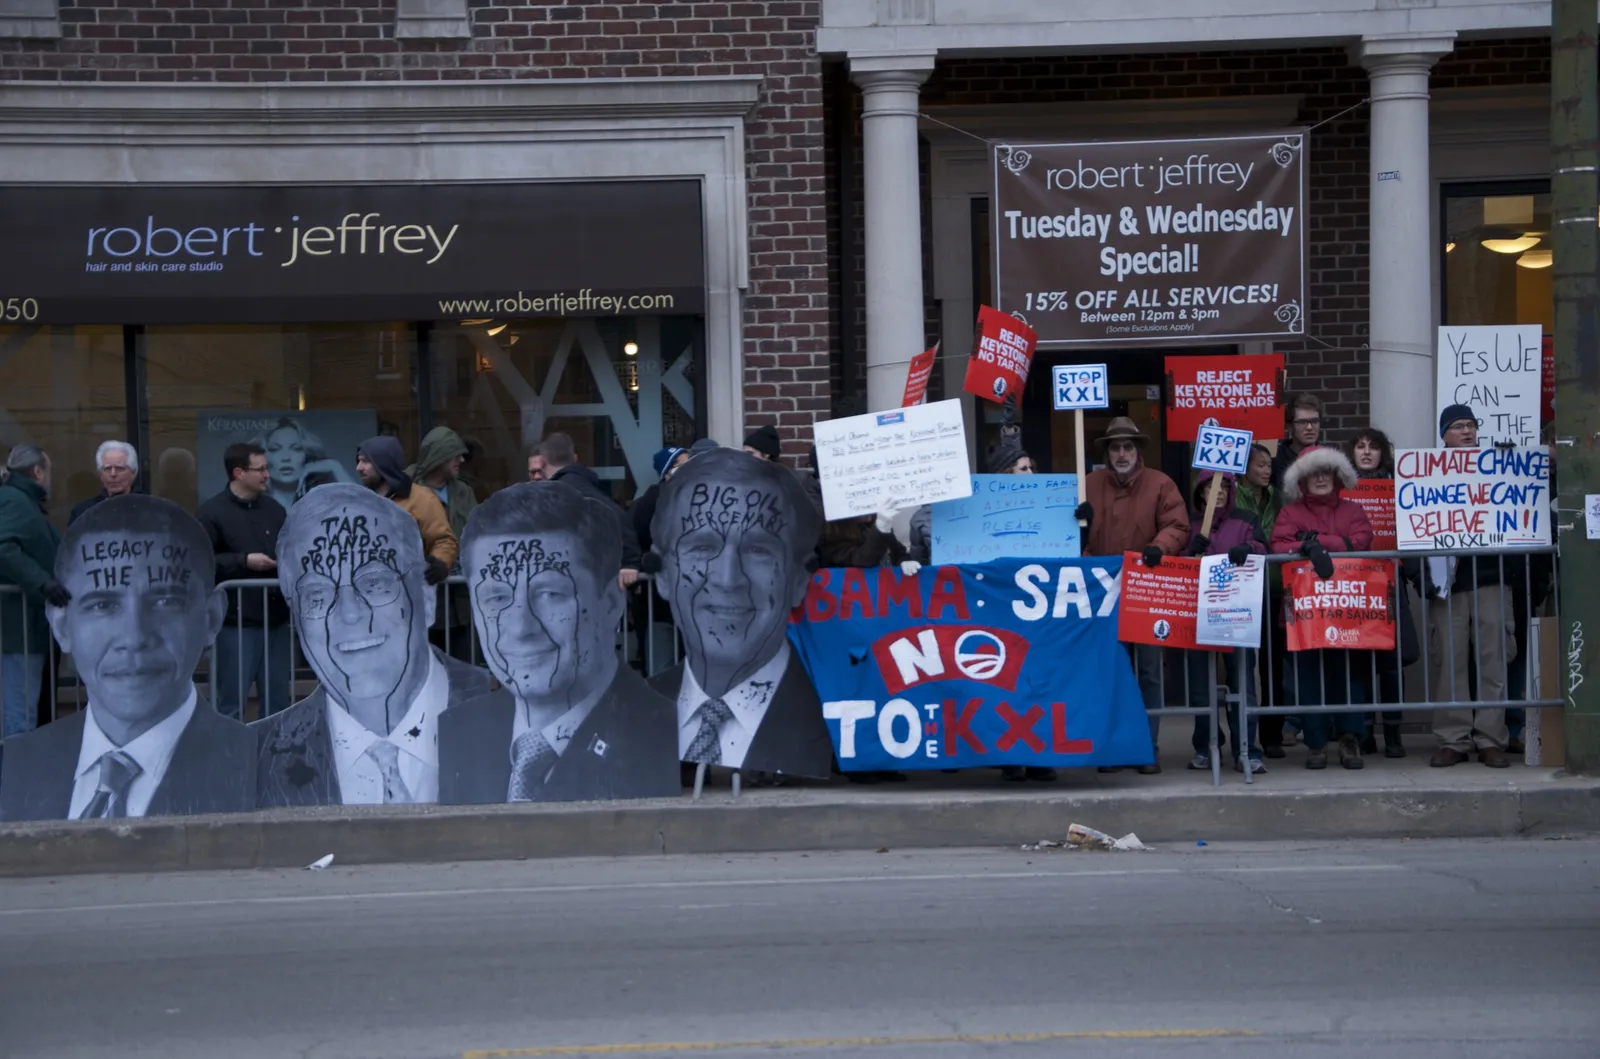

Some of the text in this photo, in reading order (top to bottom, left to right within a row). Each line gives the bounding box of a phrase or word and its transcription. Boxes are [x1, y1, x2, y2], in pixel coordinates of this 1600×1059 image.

[1004, 201, 1294, 243] Tuesday & Wednesday
[86, 261, 223, 272] hair and skin care studio
[1100, 243, 1199, 281] Special!
[438, 288, 674, 316] www.robertjeffrey.com
[1024, 284, 1279, 311] 15% OFF ALL SERVICES!
[0, 297, 39, 320] 50
[1081, 307, 1220, 323] Between 12pm & 3pm
[1106, 323, 1194, 334] (Some Exclusions Apply)
[999, 328, 1029, 353] REJECT
[978, 349, 995, 363] NO
[997, 355, 1015, 371] TAR
[1447, 333, 1489, 377] YES
[1495, 332, 1538, 373] WE
[1058, 370, 1101, 385] STOP
[1197, 370, 1252, 383] REJECT
[1059, 387, 1103, 403] KXL
[1175, 383, 1275, 398] KEYSTONE XL
[1176, 396, 1275, 408] NO TAR SANDS
[1490, 413, 1532, 436] THE
[1202, 432, 1246, 448] STOP
[1199, 447, 1243, 467] KXL
[1397, 449, 1481, 479] CLIMATE
[1046, 480, 1077, 489] FAMIL
[691, 483, 782, 516] BIG OIL
[1399, 480, 1545, 510] CHANGE WE CAN'T
[321, 514, 368, 534] TAR
[681, 510, 788, 534] MERCENARY
[982, 521, 1042, 533] PLEASE
[1409, 509, 1489, 538] BELIEVE
[313, 534, 388, 552] SANDS
[498, 538, 543, 551] TAR
[1433, 534, 1455, 549] NO
[81, 539, 189, 563] LEGACY ON
[301, 547, 397, 573] PROFITEER
[491, 551, 563, 565] SANDS
[86, 564, 192, 589] THE LINE
[1136, 580, 1160, 588] climate
[1161, 583, 1187, 591] change,
[1155, 575, 1183, 583] respond
[1012, 563, 1121, 621] SAY
[1127, 586, 1146, 594] failure
[1314, 581, 1366, 594] REJECT
[1166, 597, 1187, 605] future
[1294, 595, 1386, 611] KEYSTONE XL
[1149, 607, 1177, 616] BARACK
[1295, 608, 1386, 621] NO TAR SANDS
[889, 628, 1006, 686] NO
[822, 698, 922, 759] TO
[942, 697, 1094, 757] KXL
